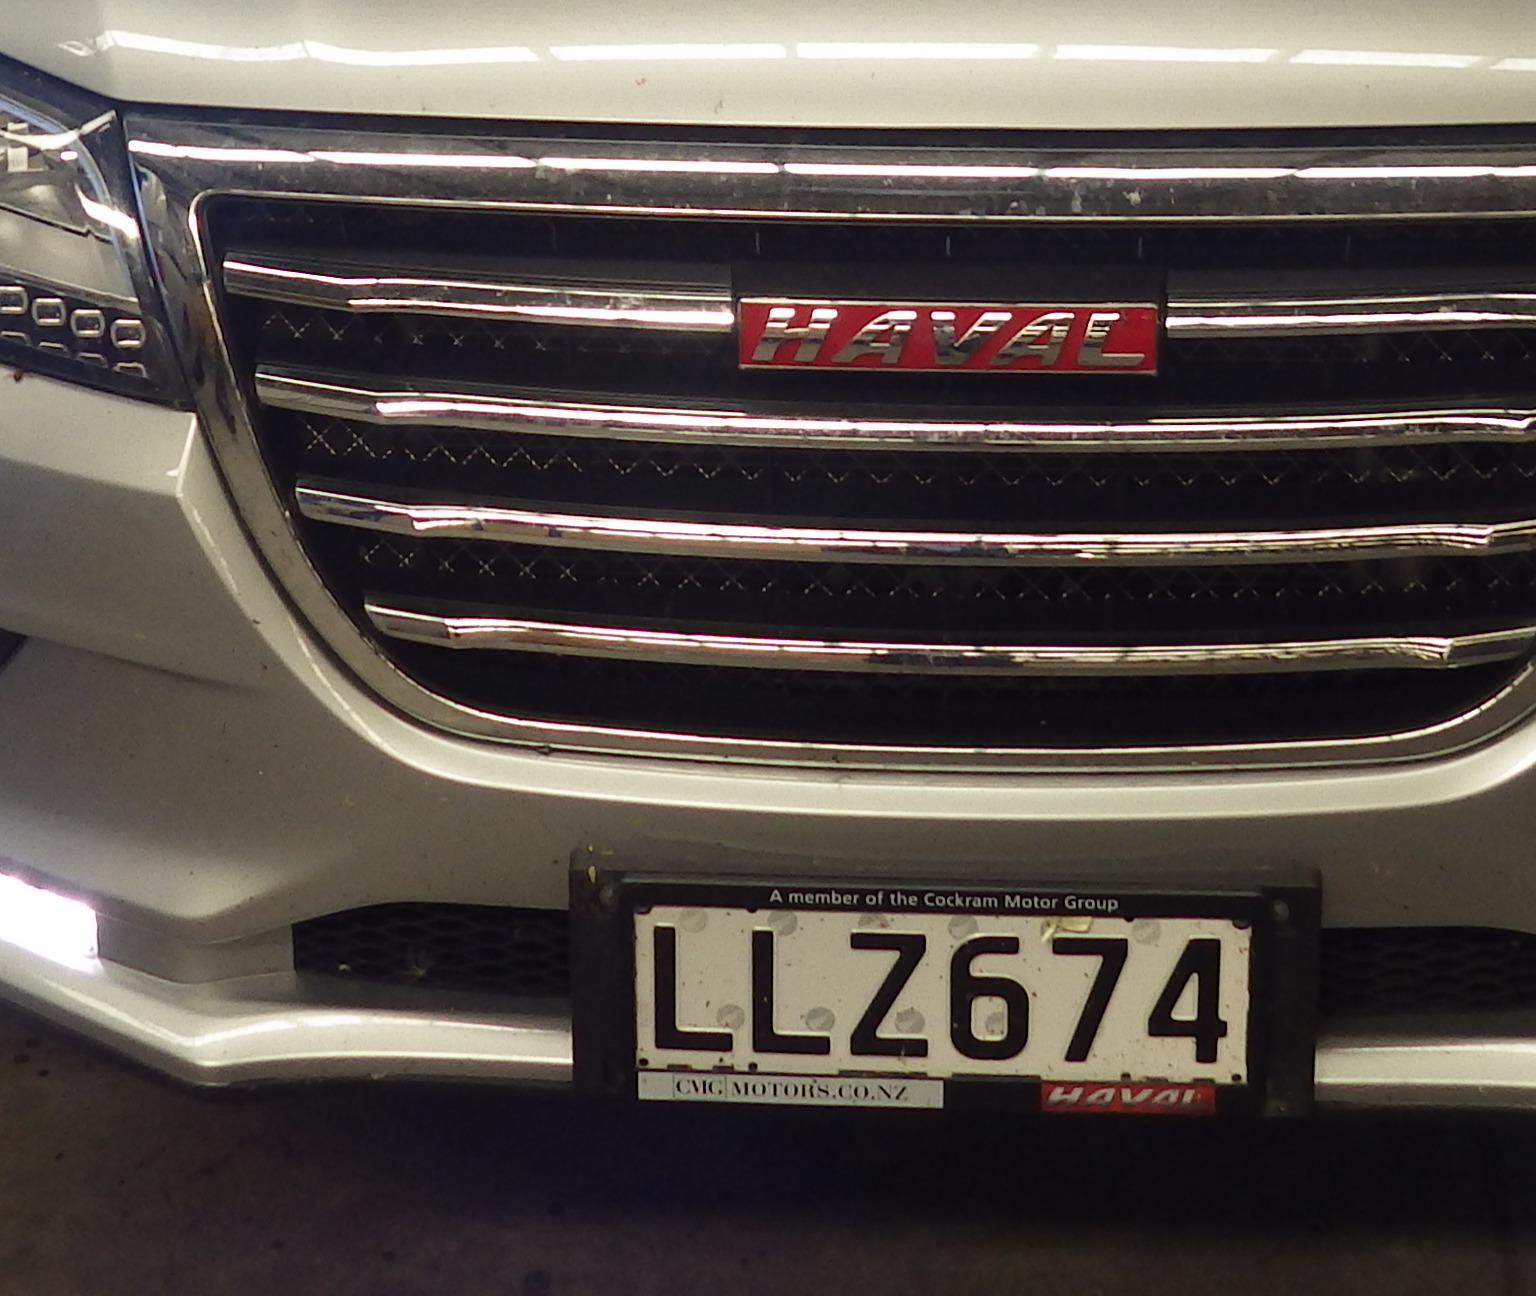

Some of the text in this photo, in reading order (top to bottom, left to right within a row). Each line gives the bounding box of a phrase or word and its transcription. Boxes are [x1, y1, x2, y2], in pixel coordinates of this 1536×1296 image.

[750, 306, 1146, 367] HAVAL
[769, 889, 1119, 913] A member of the Cockram Motor Group
[653, 923, 1228, 1064] LLZ674
